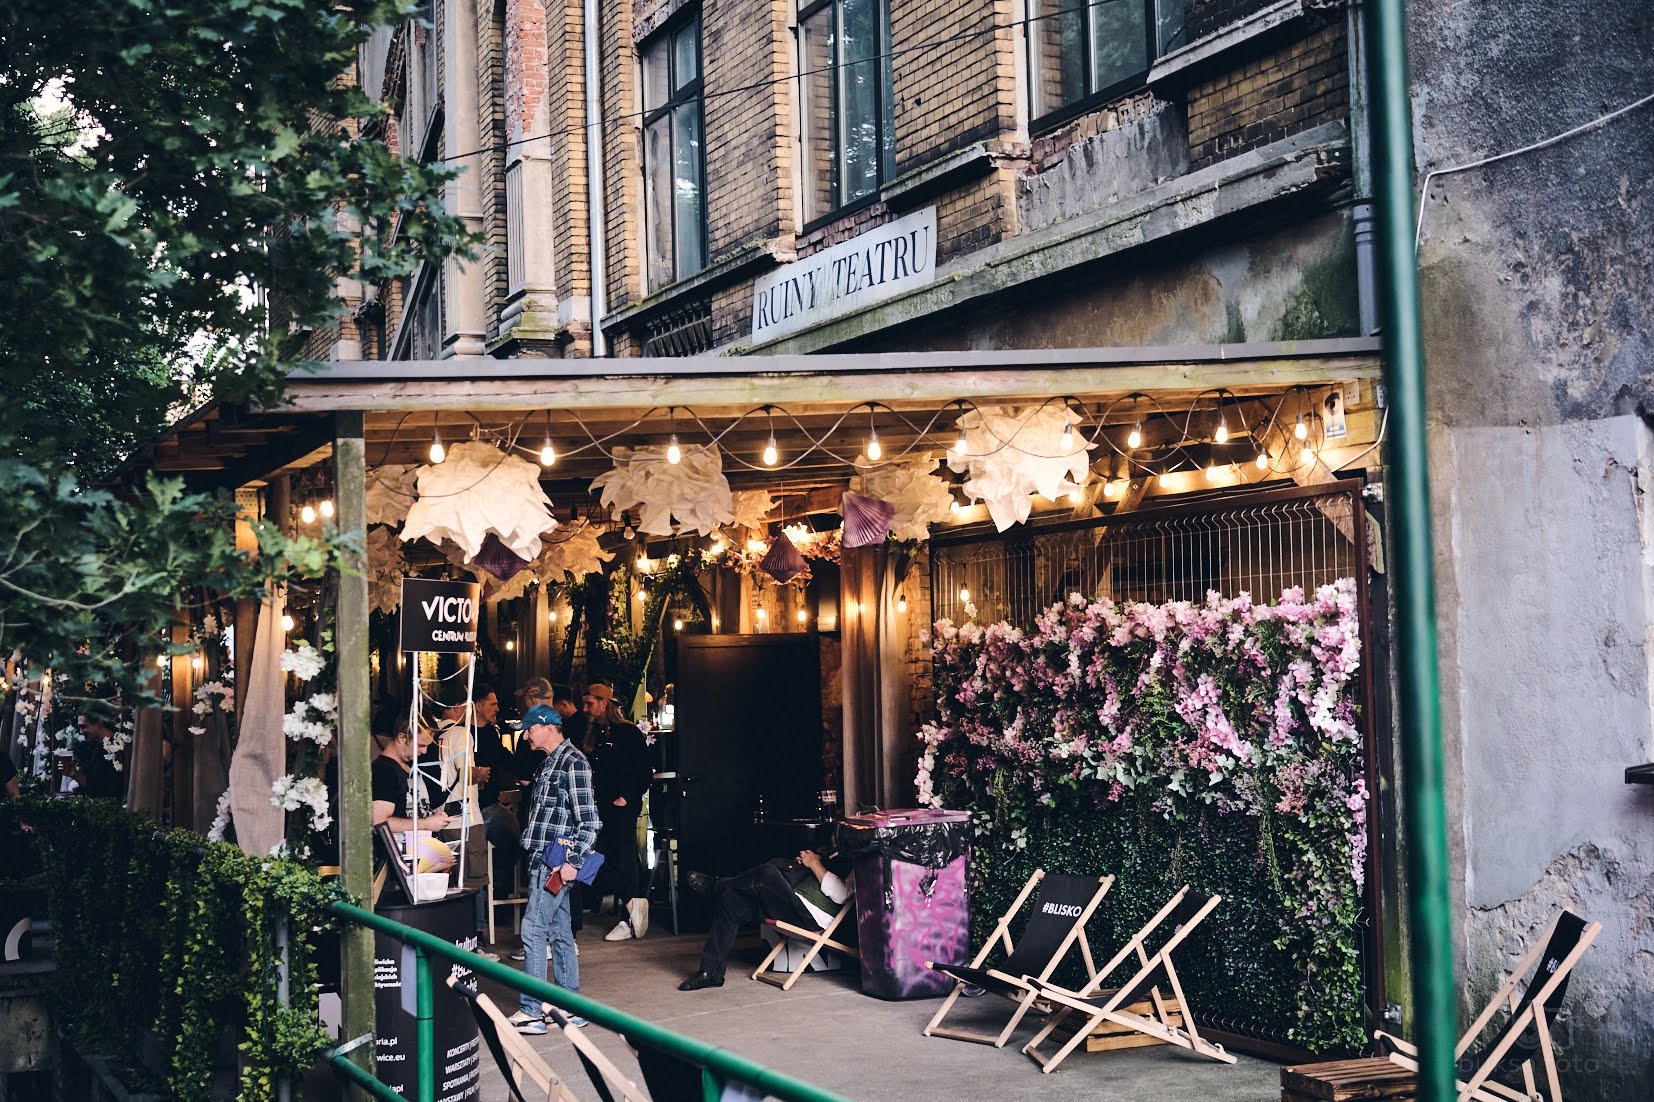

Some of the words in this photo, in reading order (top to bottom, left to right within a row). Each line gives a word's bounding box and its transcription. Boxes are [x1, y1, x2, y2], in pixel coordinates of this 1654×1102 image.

[757, 267, 821, 330] RUINY
[832, 226, 929, 299] TEATRU
[432, 630, 464, 642] CENTRUM
[1041, 901, 1082, 918] #BLISKO
[375, 1037, 398, 1047] oria.pl
[376, 1054, 406, 1062] wice.eu
